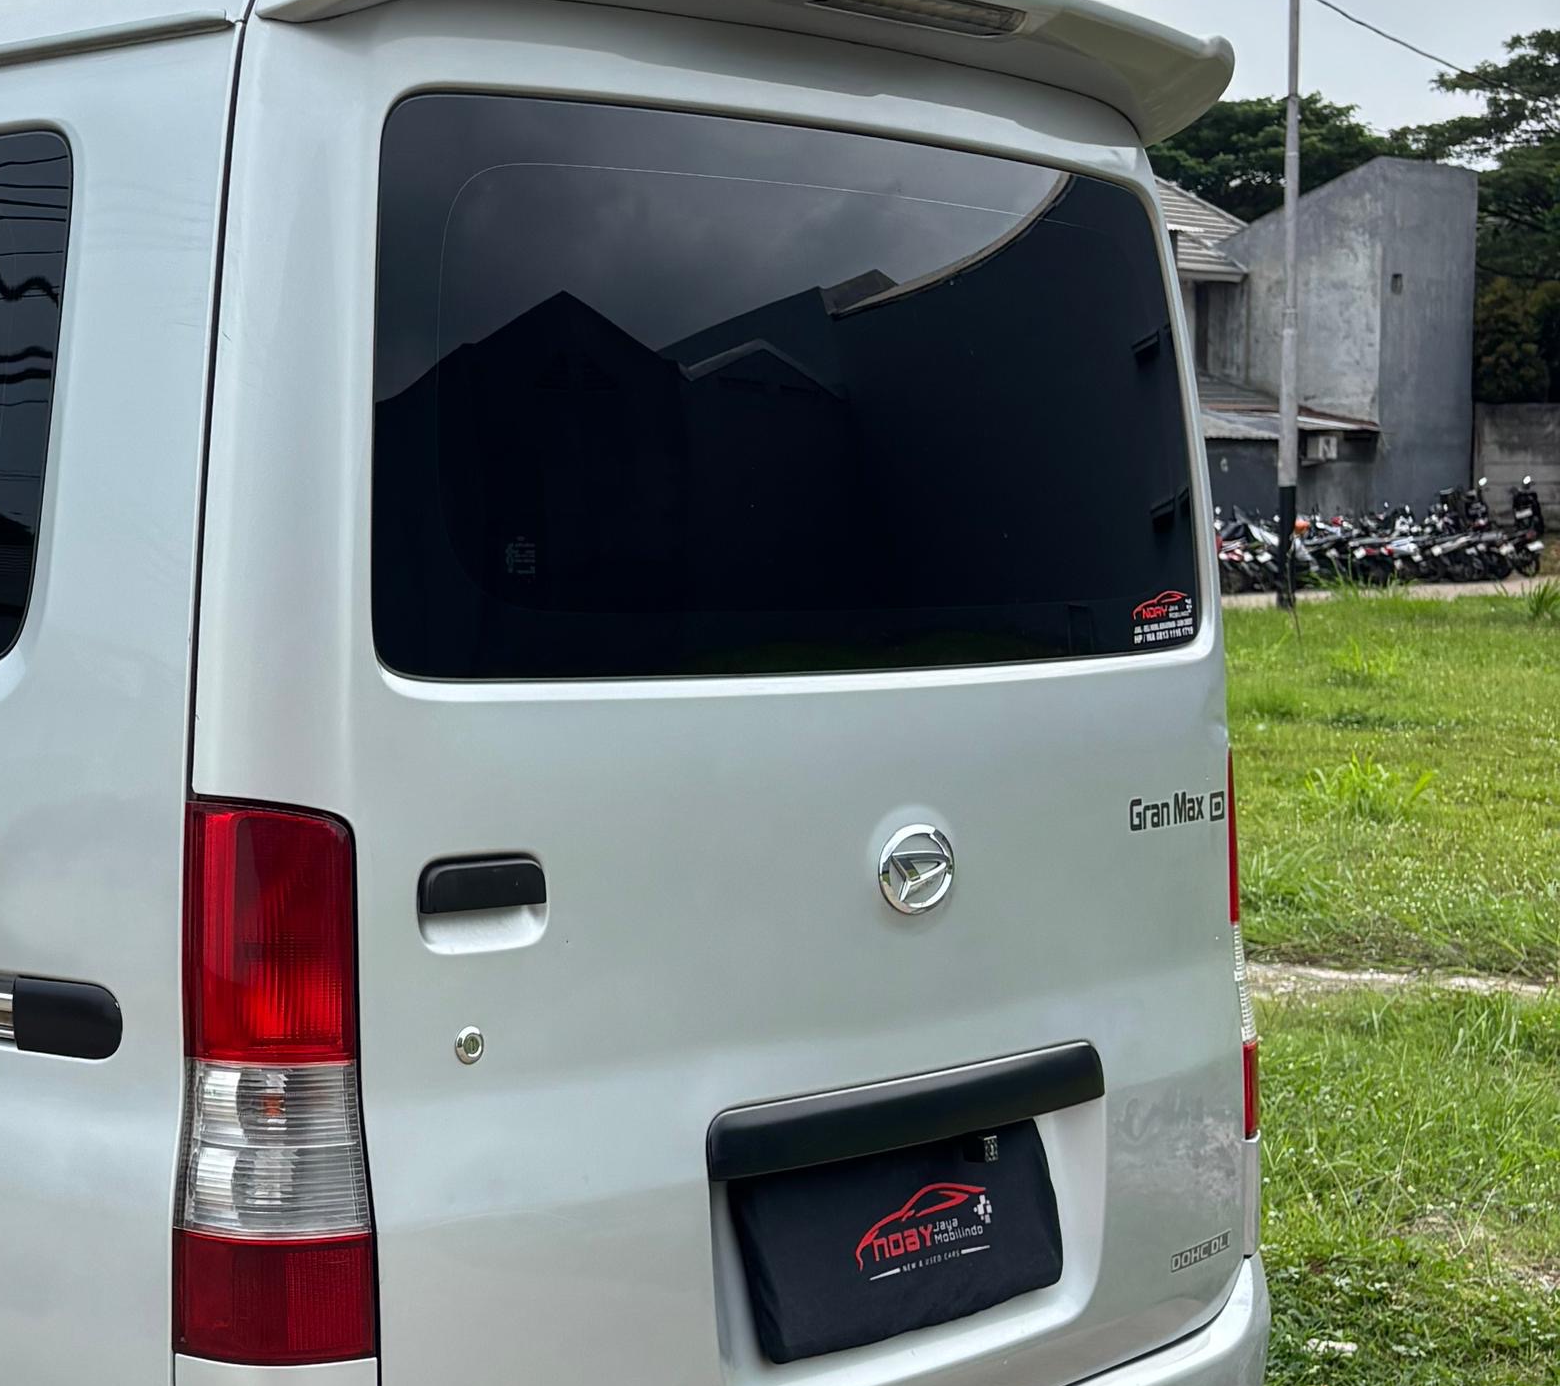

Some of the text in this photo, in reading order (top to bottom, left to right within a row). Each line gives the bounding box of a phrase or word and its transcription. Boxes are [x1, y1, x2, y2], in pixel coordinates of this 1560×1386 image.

[1129, 798, 1170, 831] Gran
[1173, 791, 1205, 824] Max
[933, 1217, 959, 1233] Jaya
[934, 1225, 983, 1244] Mobilindo
[902, 1262, 916, 1272] NEW
[925, 1254, 942, 1266] USED
[1171, 1242, 1209, 1271] DOHC
